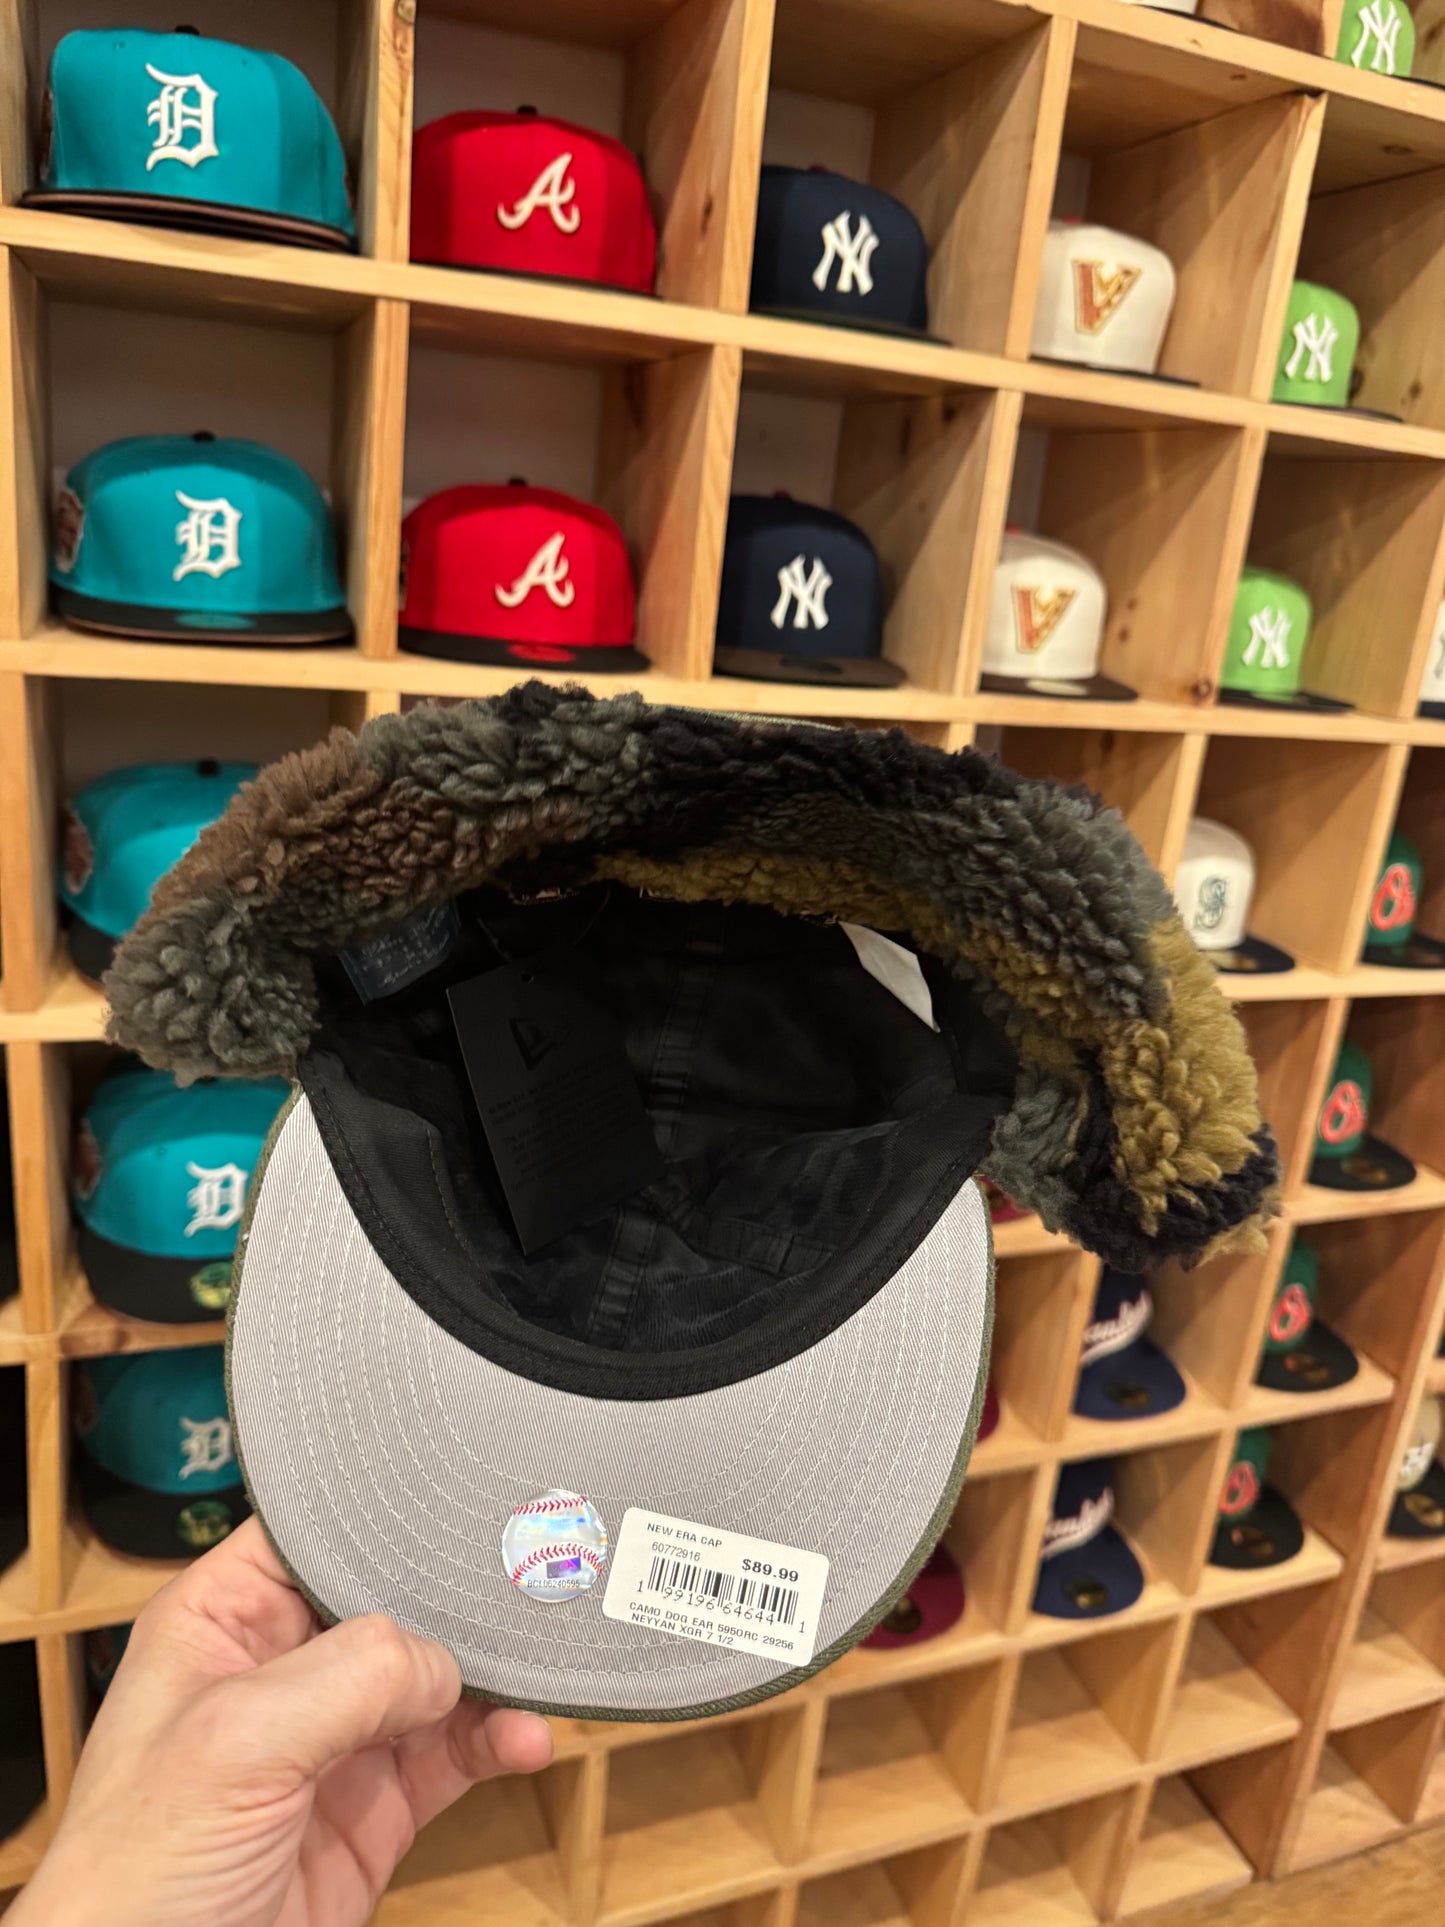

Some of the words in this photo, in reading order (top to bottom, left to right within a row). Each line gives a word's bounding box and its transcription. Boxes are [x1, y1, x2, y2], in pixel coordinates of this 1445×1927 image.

[145, 62, 219, 171] D
[497, 152, 581, 234] A
[812, 210, 879, 296] NY
[1285, 312, 1338, 382] NY
[172, 489, 242, 582] D
[495, 531, 575, 608] A
[770, 554, 833, 629] NY
[647, 1522, 673, 1536] NEW
[676, 1529, 697, 1542] ERA
[700, 1536, 722, 1548] CAP
[651, 1541, 701, 1562] 60772916
[741, 1558, 799, 1582] $89.99
[629, 1601, 661, 1617] CAMO
[665, 1610, 688, 1624] DOG
[692, 1617, 714, 1630] EAR
[762, 1635, 794, 1650] 29256
[631, 1612, 676, 1631] NEYYAN
[707, 1631, 714, 1640] 7
[718, 1634, 735, 1646] 1/2
[637, 1580, 643, 1593] 1
[663, 1586, 716, 1611] 99196
[722, 1602, 775, 1626] 64644
[798, 1620, 805, 1634] 1
